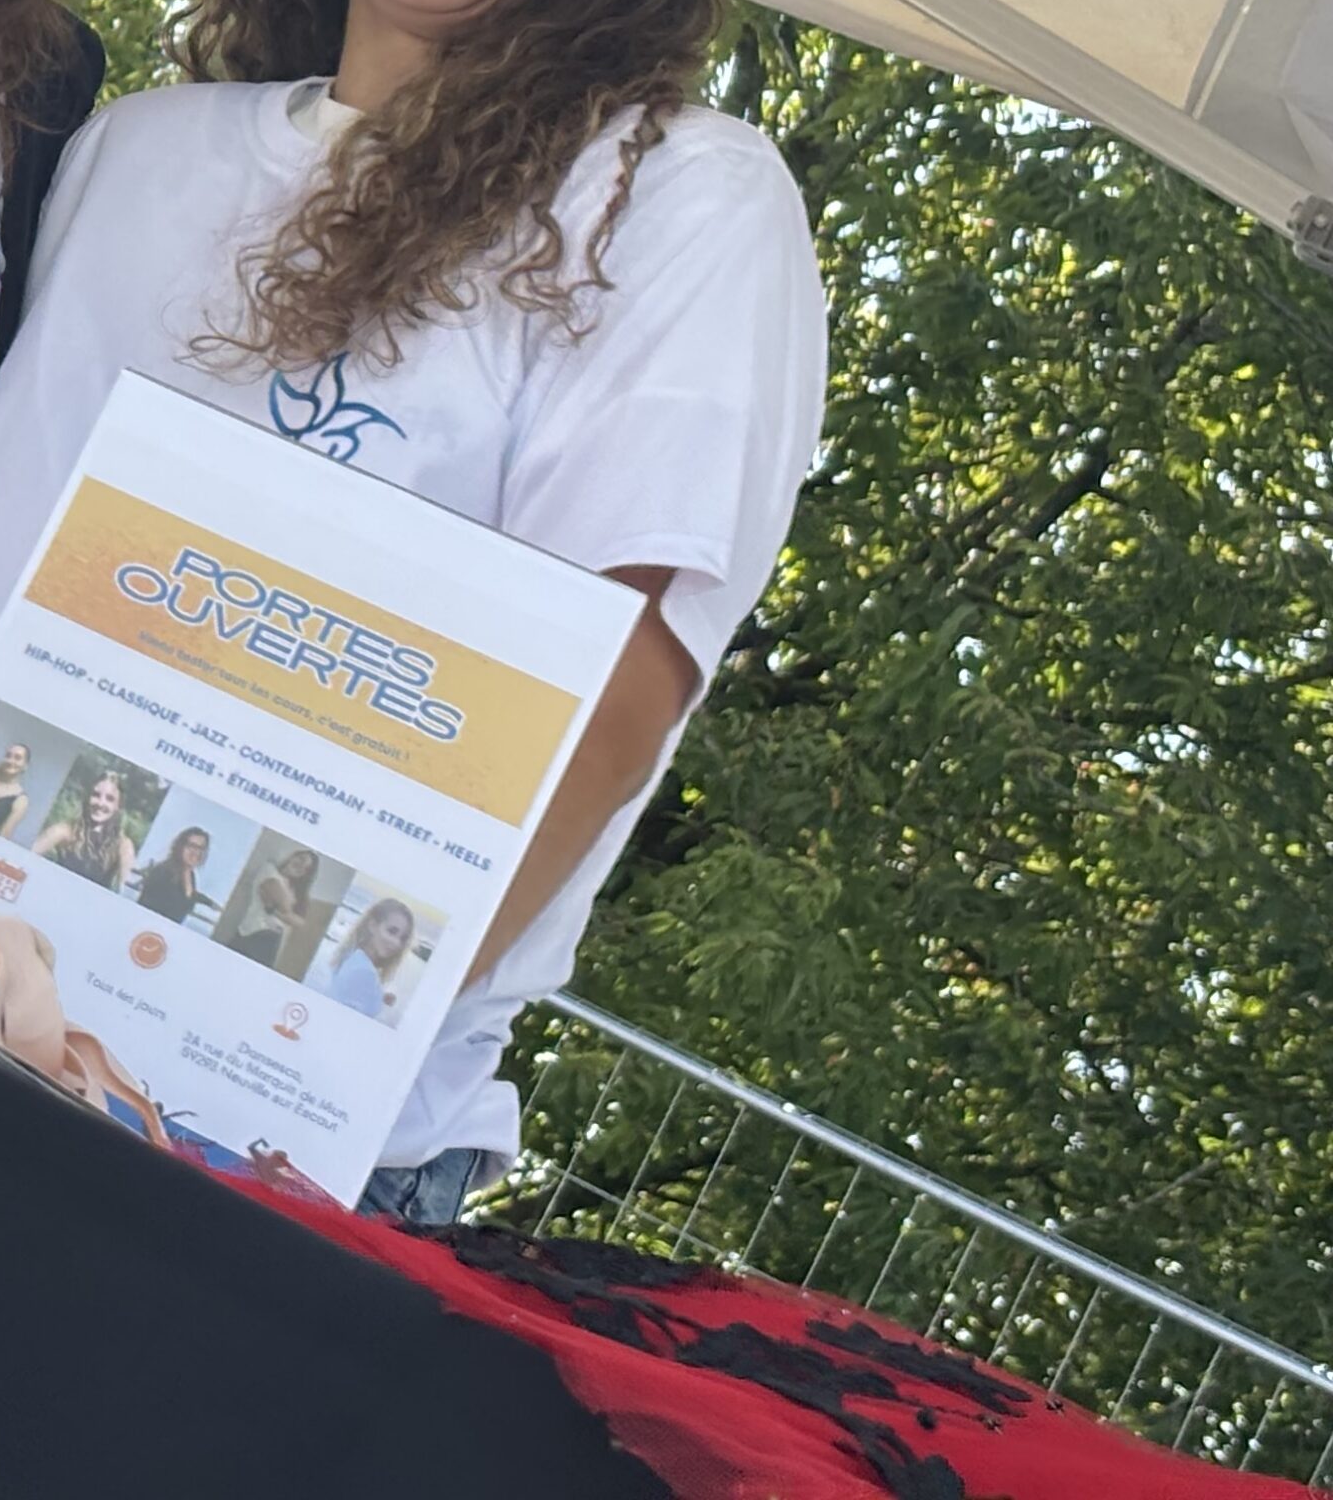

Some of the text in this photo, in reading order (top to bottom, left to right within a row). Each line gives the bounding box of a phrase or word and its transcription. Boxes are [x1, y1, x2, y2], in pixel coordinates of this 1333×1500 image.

[113, 561, 465, 743] OUVERTES
[173, 549, 437, 688] PORTES
[24, 643, 87, 678] HIP-HOP
[96, 678, 180, 724] CLASSIQUE
[189, 722, 229, 748] JAZZ
[238, 745, 365, 812] CONTEMPORAIN
[376, 809, 432, 842] STREET
[442, 840, 491, 871] HEELS
[249, 681, 270, 700] les
[271, 694, 313, 721] cours,
[316, 714, 353, 737] c'est
[350, 731, 401, 761] gratuit
[154, 738, 215, 775] FITNESS
[226, 771, 319, 825] ÉTIREMENTS
[86, 970, 167, 1021] Tous les jours
[203, 1042, 224, 1059] rue
[224, 1053, 244, 1069] du
[298, 1090, 316, 1105] de
[270, 1093, 293, 1108] sur
[292, 1101, 338, 1132] Escaut
